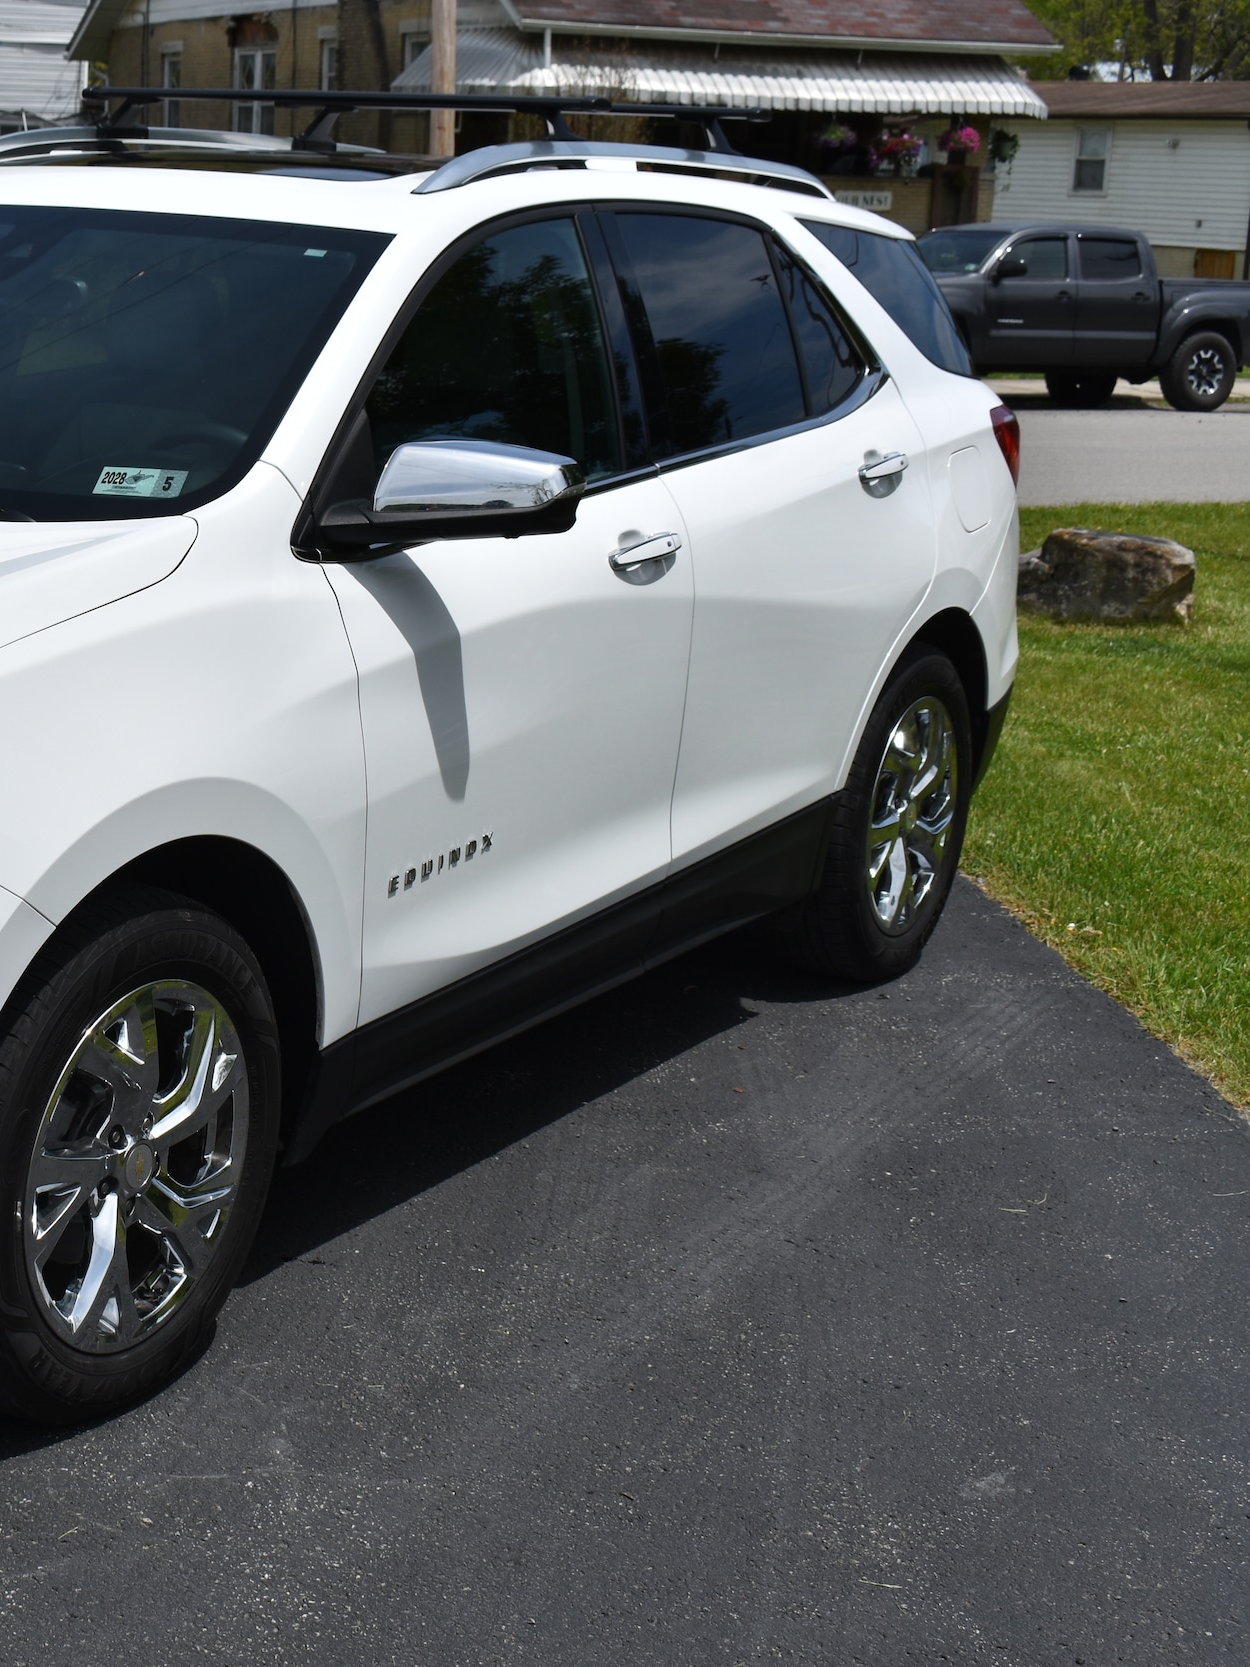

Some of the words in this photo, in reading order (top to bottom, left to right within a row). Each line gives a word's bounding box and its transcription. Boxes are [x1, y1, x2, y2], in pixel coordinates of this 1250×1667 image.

[101, 471, 127, 485] 2028
[162, 476, 174, 492] 5
[387, 831, 493, 896] EQUINOX
